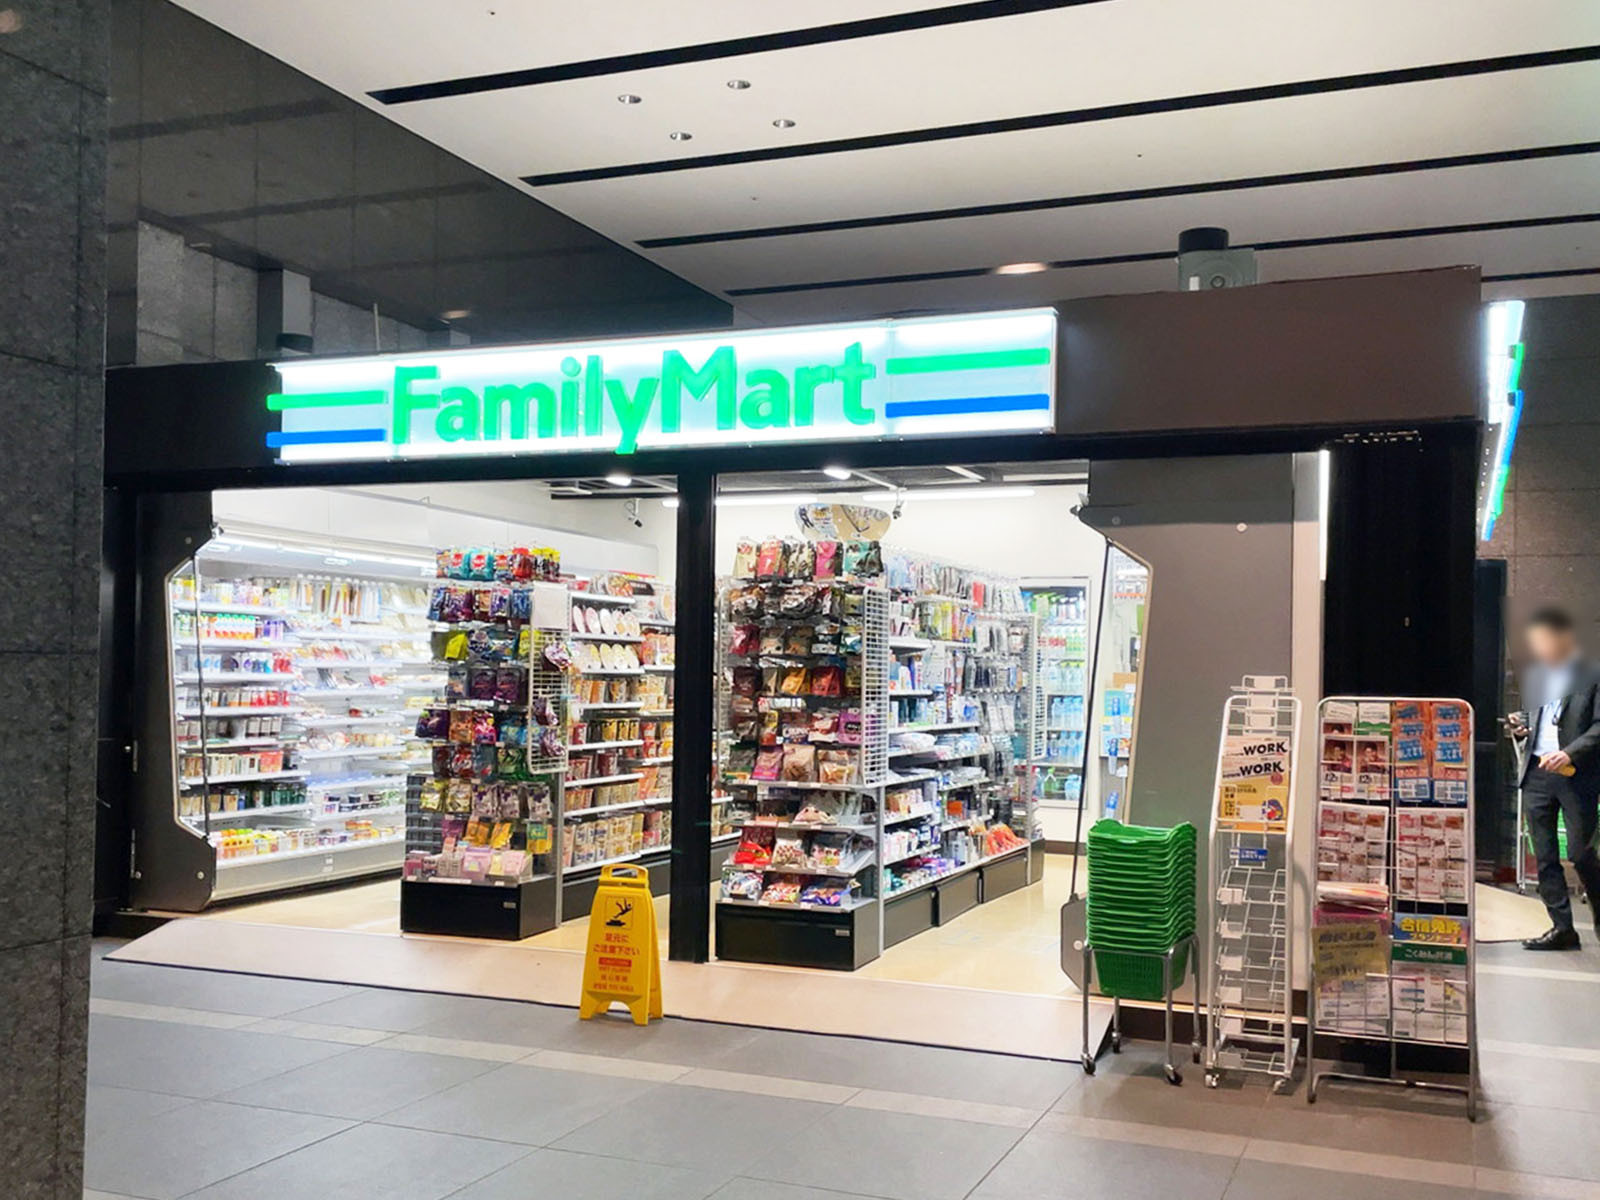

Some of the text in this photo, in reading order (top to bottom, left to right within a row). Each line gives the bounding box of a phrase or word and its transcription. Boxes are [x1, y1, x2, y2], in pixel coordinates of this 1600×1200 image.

[392, 342, 875, 453] FamilyMart
[1243, 741, 1288, 756] WORK
[1239, 761, 1285, 776] WORK
